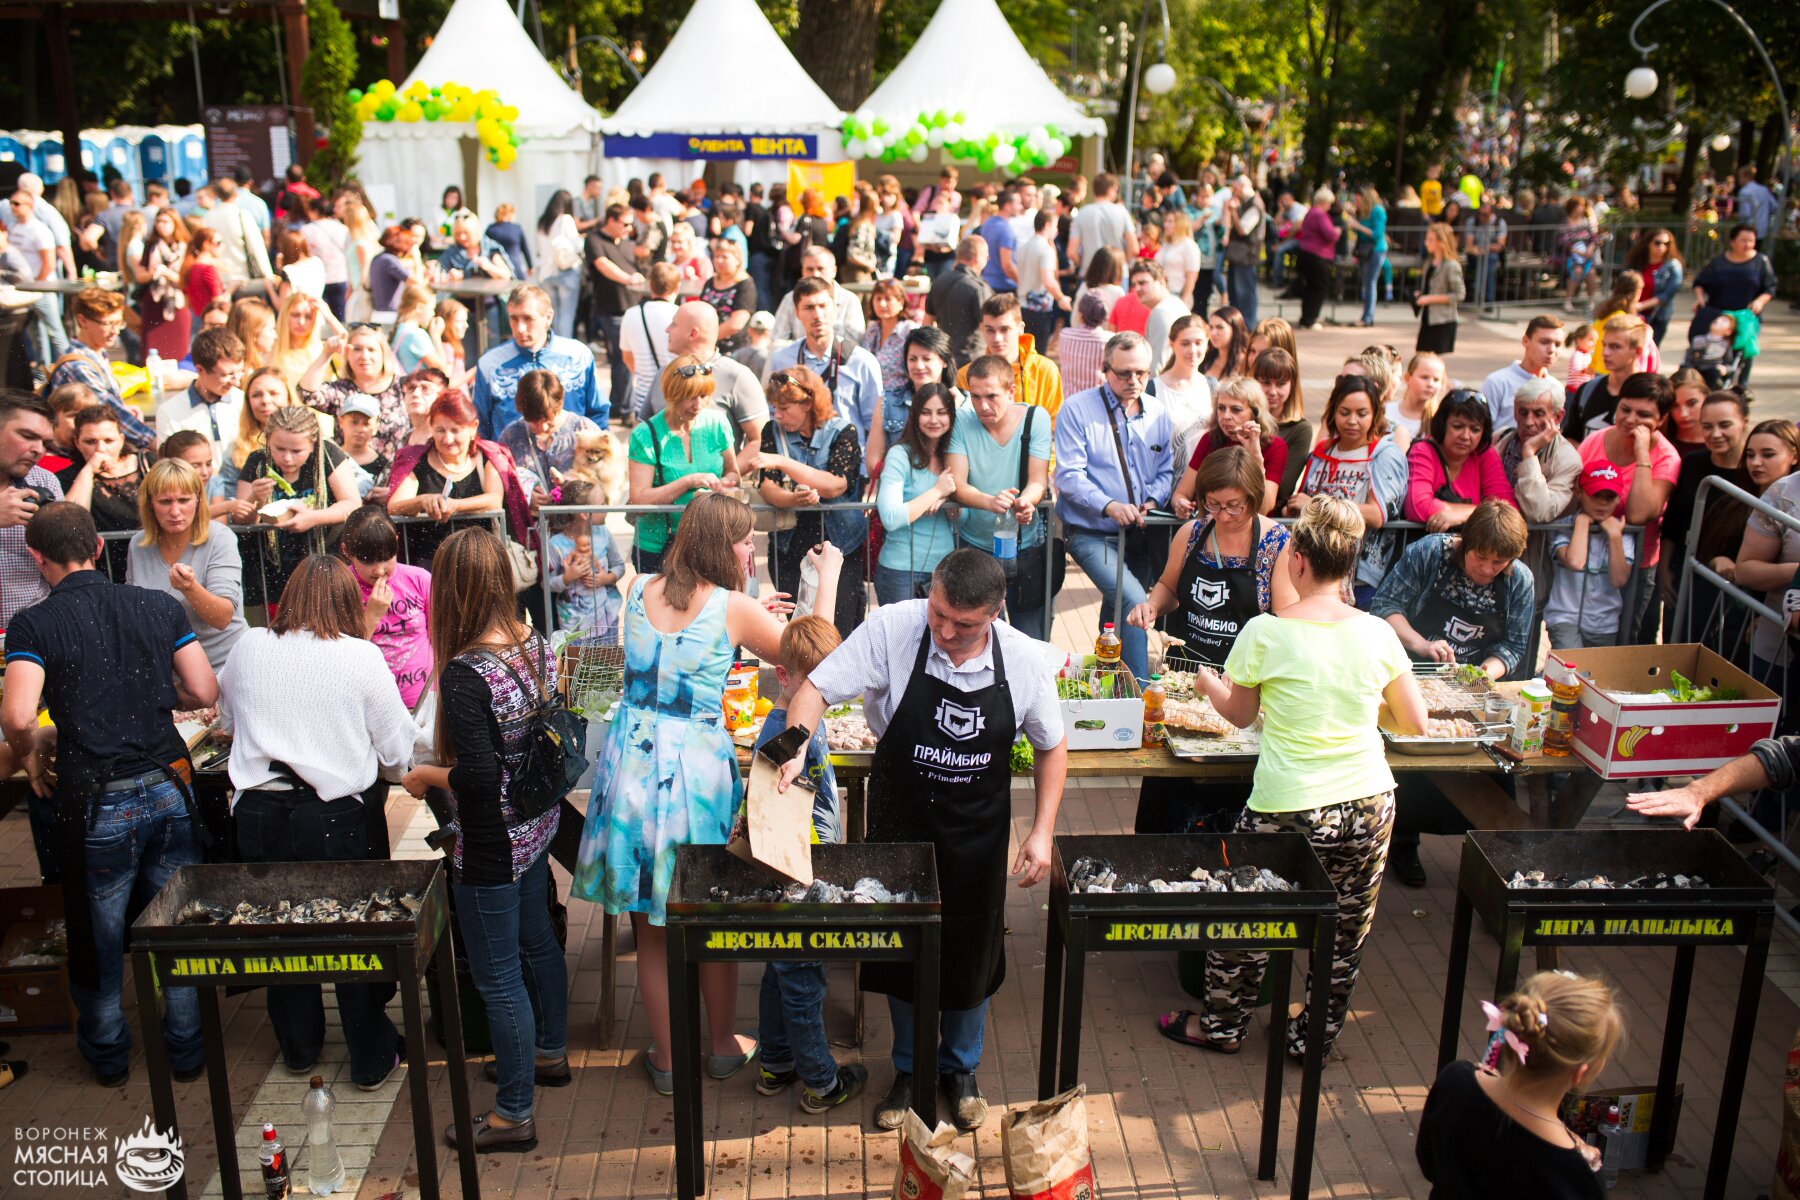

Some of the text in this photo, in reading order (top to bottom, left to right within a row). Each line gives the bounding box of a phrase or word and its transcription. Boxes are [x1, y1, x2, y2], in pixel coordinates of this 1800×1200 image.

[1188, 611, 1238, 632] ПРАЙМБИФ
[913, 744, 992, 767] ПРАЙМБИФ
[927, 771, 974, 784] PrimeBeef
[1105, 921, 1298, 941] ЛЕСНАЯ СКАЗКА
[1535, 918, 1735, 936] ЛИГА ШАШЛЫКА
[706, 931, 903, 950] ЛЕСНАЯ СКАЗКА
[171, 953, 384, 976] ЛИГА ШАШЛЫКА
